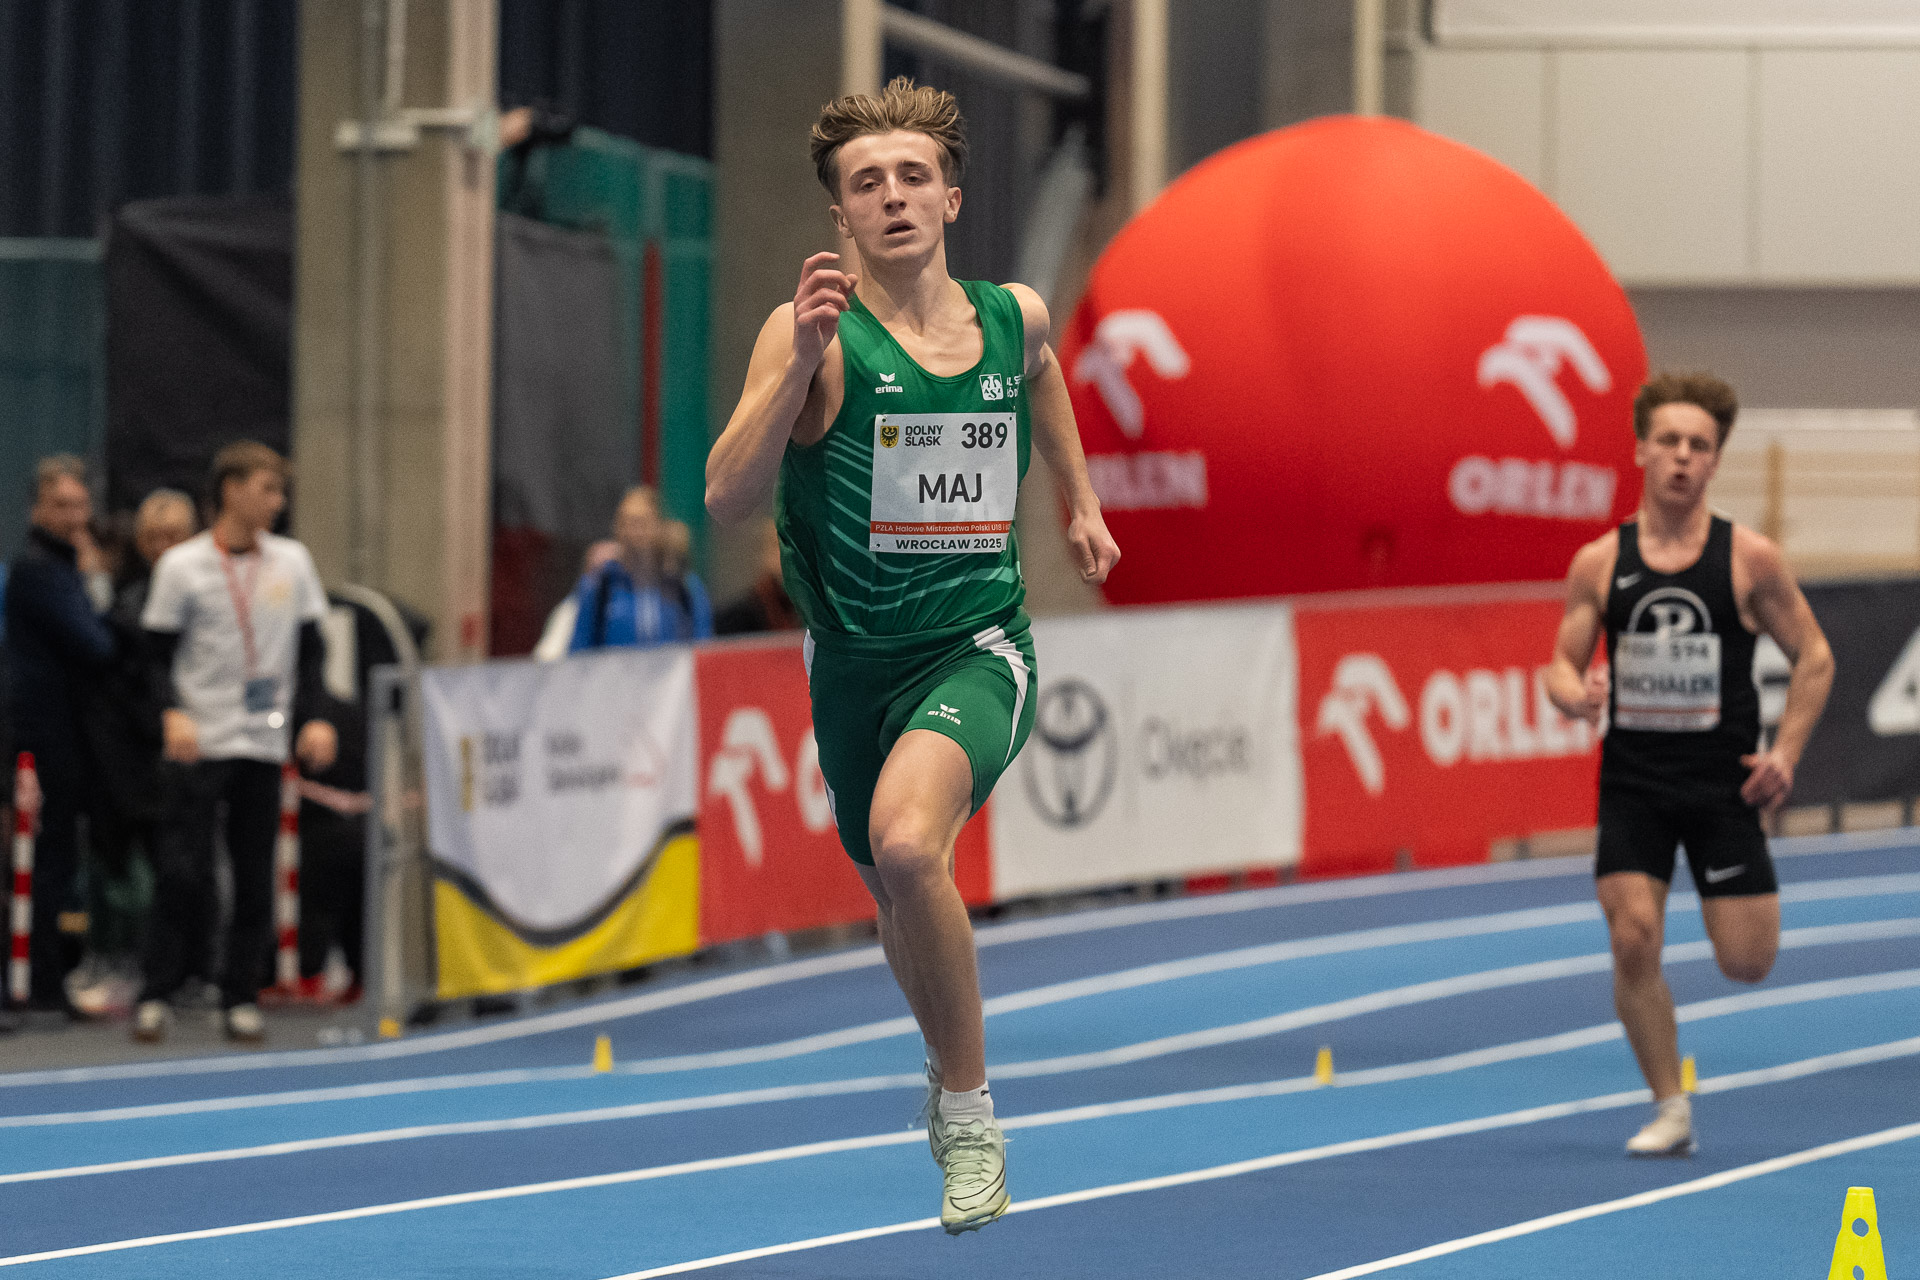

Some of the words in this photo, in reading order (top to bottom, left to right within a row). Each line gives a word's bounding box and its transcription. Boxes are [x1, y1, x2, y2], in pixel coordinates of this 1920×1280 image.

[875, 384, 903, 394] erima
[905, 424, 944, 435] DOLNY
[961, 422, 1008, 449] 389
[904, 433, 941, 447] ŚLĄSK
[918, 473, 983, 503] MAJ
[1448, 456, 1618, 521] ORLEN
[875, 524, 894, 532] PZLA
[895, 525, 925, 533] Halowe
[925, 524, 970, 533] Mistrzostwa
[970, 524, 990, 532] Polski
[895, 539, 970, 550] WROCŁAW
[973, 538, 1002, 549] 2025
[927, 710, 962, 726] erima
